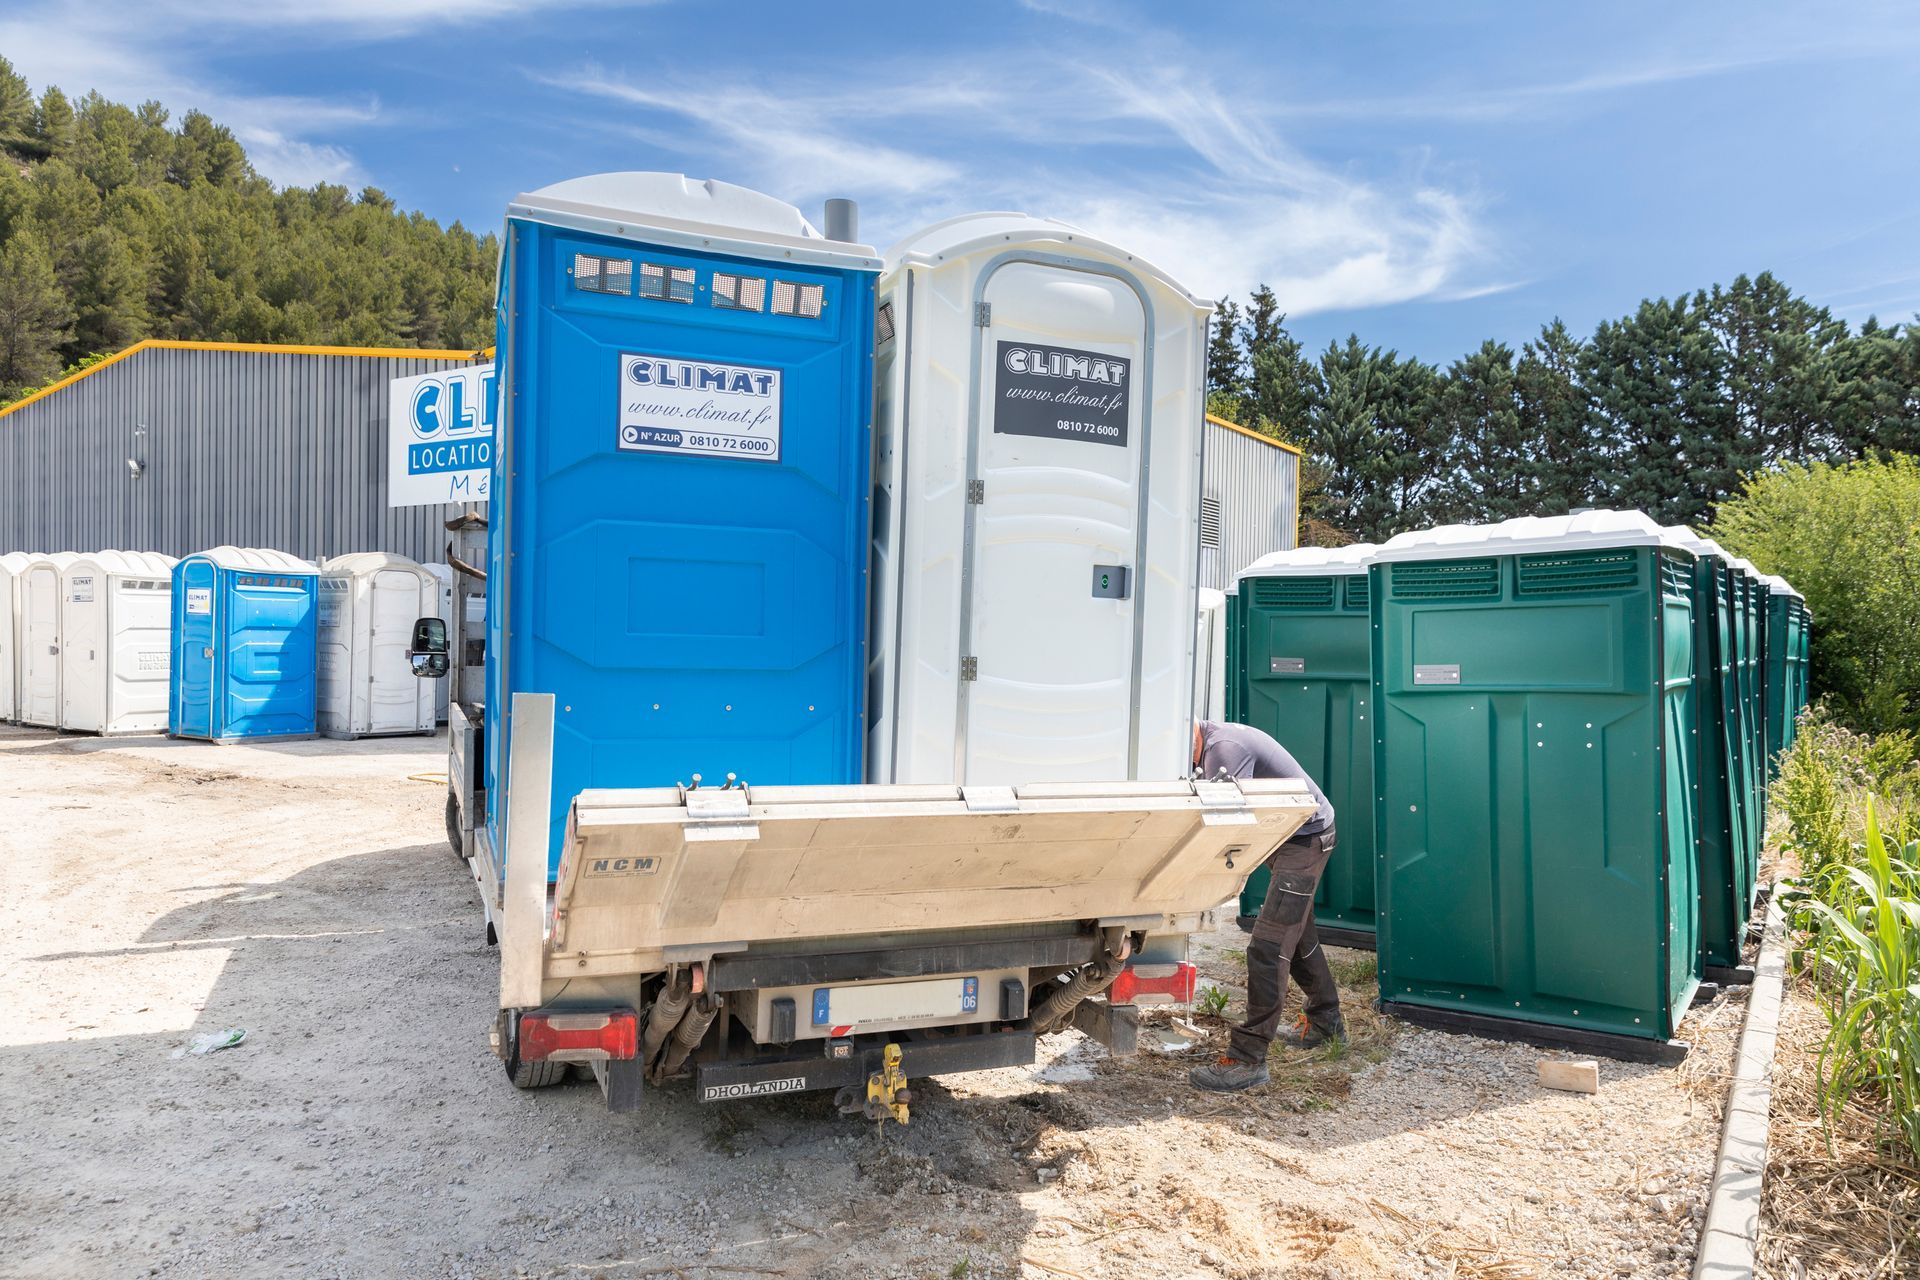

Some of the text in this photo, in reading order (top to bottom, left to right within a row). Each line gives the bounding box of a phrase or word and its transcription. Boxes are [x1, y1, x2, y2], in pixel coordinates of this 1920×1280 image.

[1005, 348, 1126, 387] CLIMAT
[627, 358, 775, 398] CLIMAT
[1006, 385, 1123, 415] www.climat.fr
[628, 400, 772, 430] www.climat.fr
[1057, 420, 1119, 437] 0810 72 6000
[640, 431, 769, 451] N° AZUR 0810 72 6000
[593, 858, 653, 871] NCM
[963, 995, 976, 1008] 06
[818, 1009, 825, 1018] F
[706, 1078, 804, 1099] DHOLLANDIA
